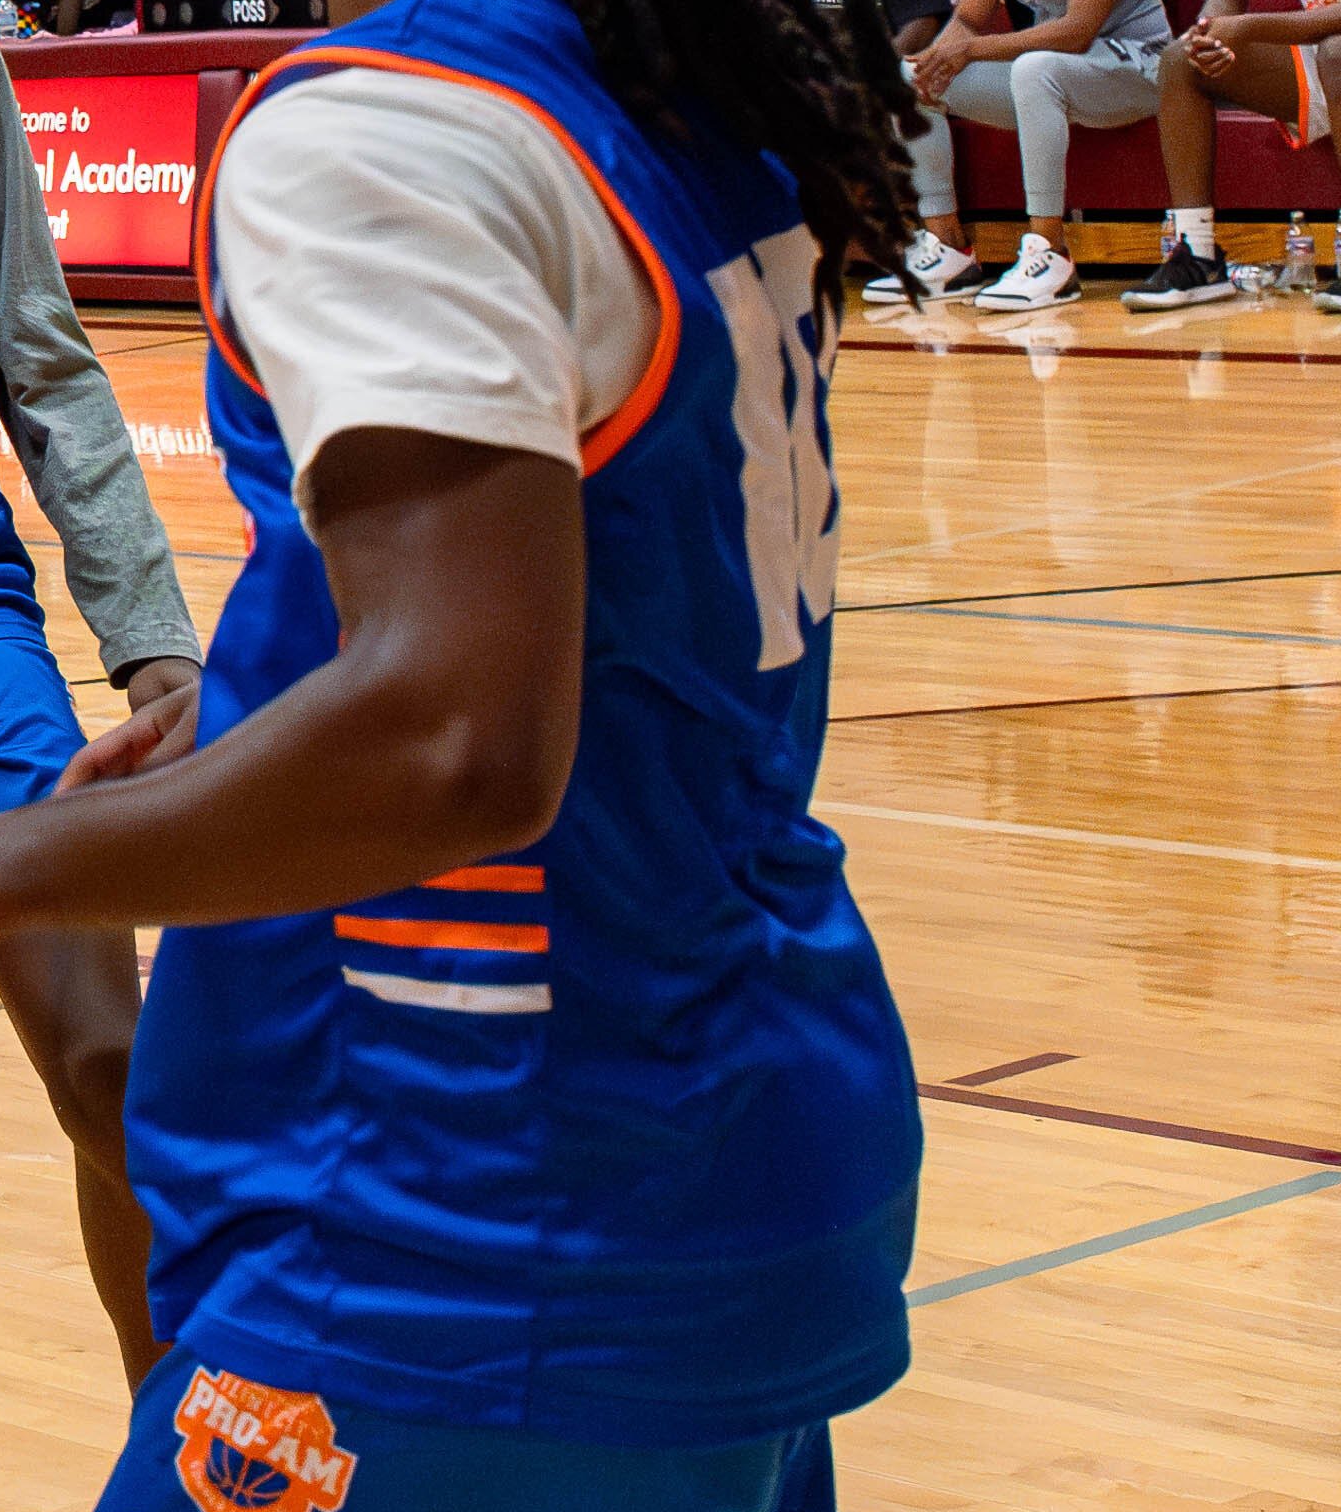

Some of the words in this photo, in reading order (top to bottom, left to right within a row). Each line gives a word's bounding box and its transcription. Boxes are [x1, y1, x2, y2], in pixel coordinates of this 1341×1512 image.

[17, 102, 67, 133] come
[71, 105, 91, 133] to
[59, 147, 197, 206] Academy
[184, 1378, 343, 1495] PRO-AM
